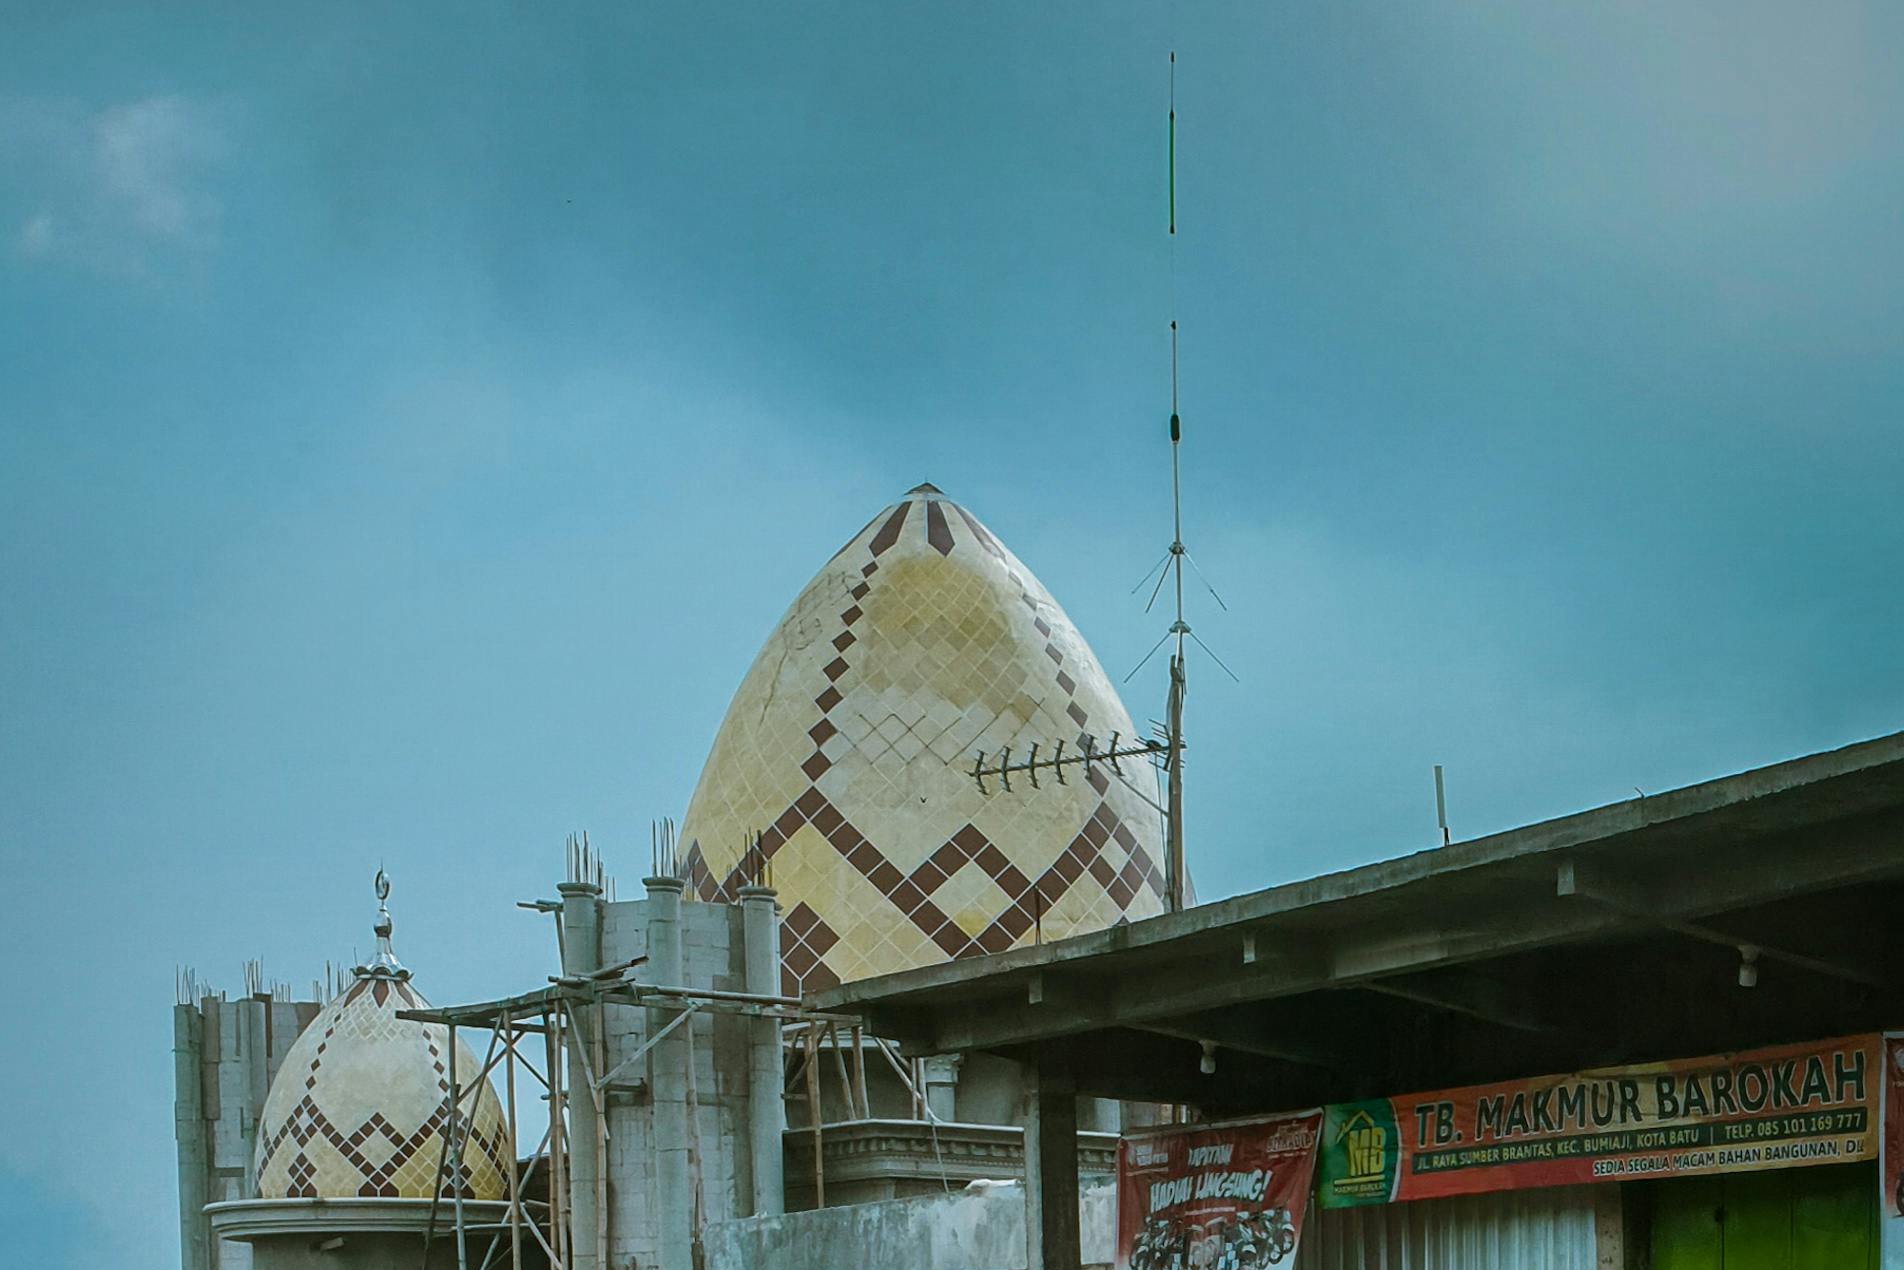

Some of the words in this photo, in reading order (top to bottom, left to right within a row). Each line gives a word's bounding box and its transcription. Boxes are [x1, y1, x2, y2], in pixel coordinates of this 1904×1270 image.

[1415, 1101, 1462, 1149] TB.
[1475, 1078, 1643, 1142] MAKMUR
[1655, 1050, 1866, 1121] BAROKAH
[1432, 1153, 1458, 1168] RAYA
[1459, 1149, 1500, 1165] SUMBER
[1557, 1140, 1580, 1155] KEC.
[1584, 1135, 1632, 1152] BUMIAJI,
[1637, 1131, 1666, 1148] KOTA
[1670, 1129, 1699, 1145] BATU
[1725, 1122, 1754, 1139] TELP.
[1757, 1120, 1779, 1136] 085
[1784, 1117, 1806, 1134] 101
[1811, 1115, 1833, 1131] 169
[1837, 1112, 1861, 1129] 777
[1593, 1158, 1625, 1177] SEDIA
[1628, 1155, 1671, 1173] SEGALA
[1673, 1151, 1715, 1169] MACAM
[1718, 1147, 1761, 1165] BAHAN
[1765, 1141, 1841, 1160] BANGUNAN,
